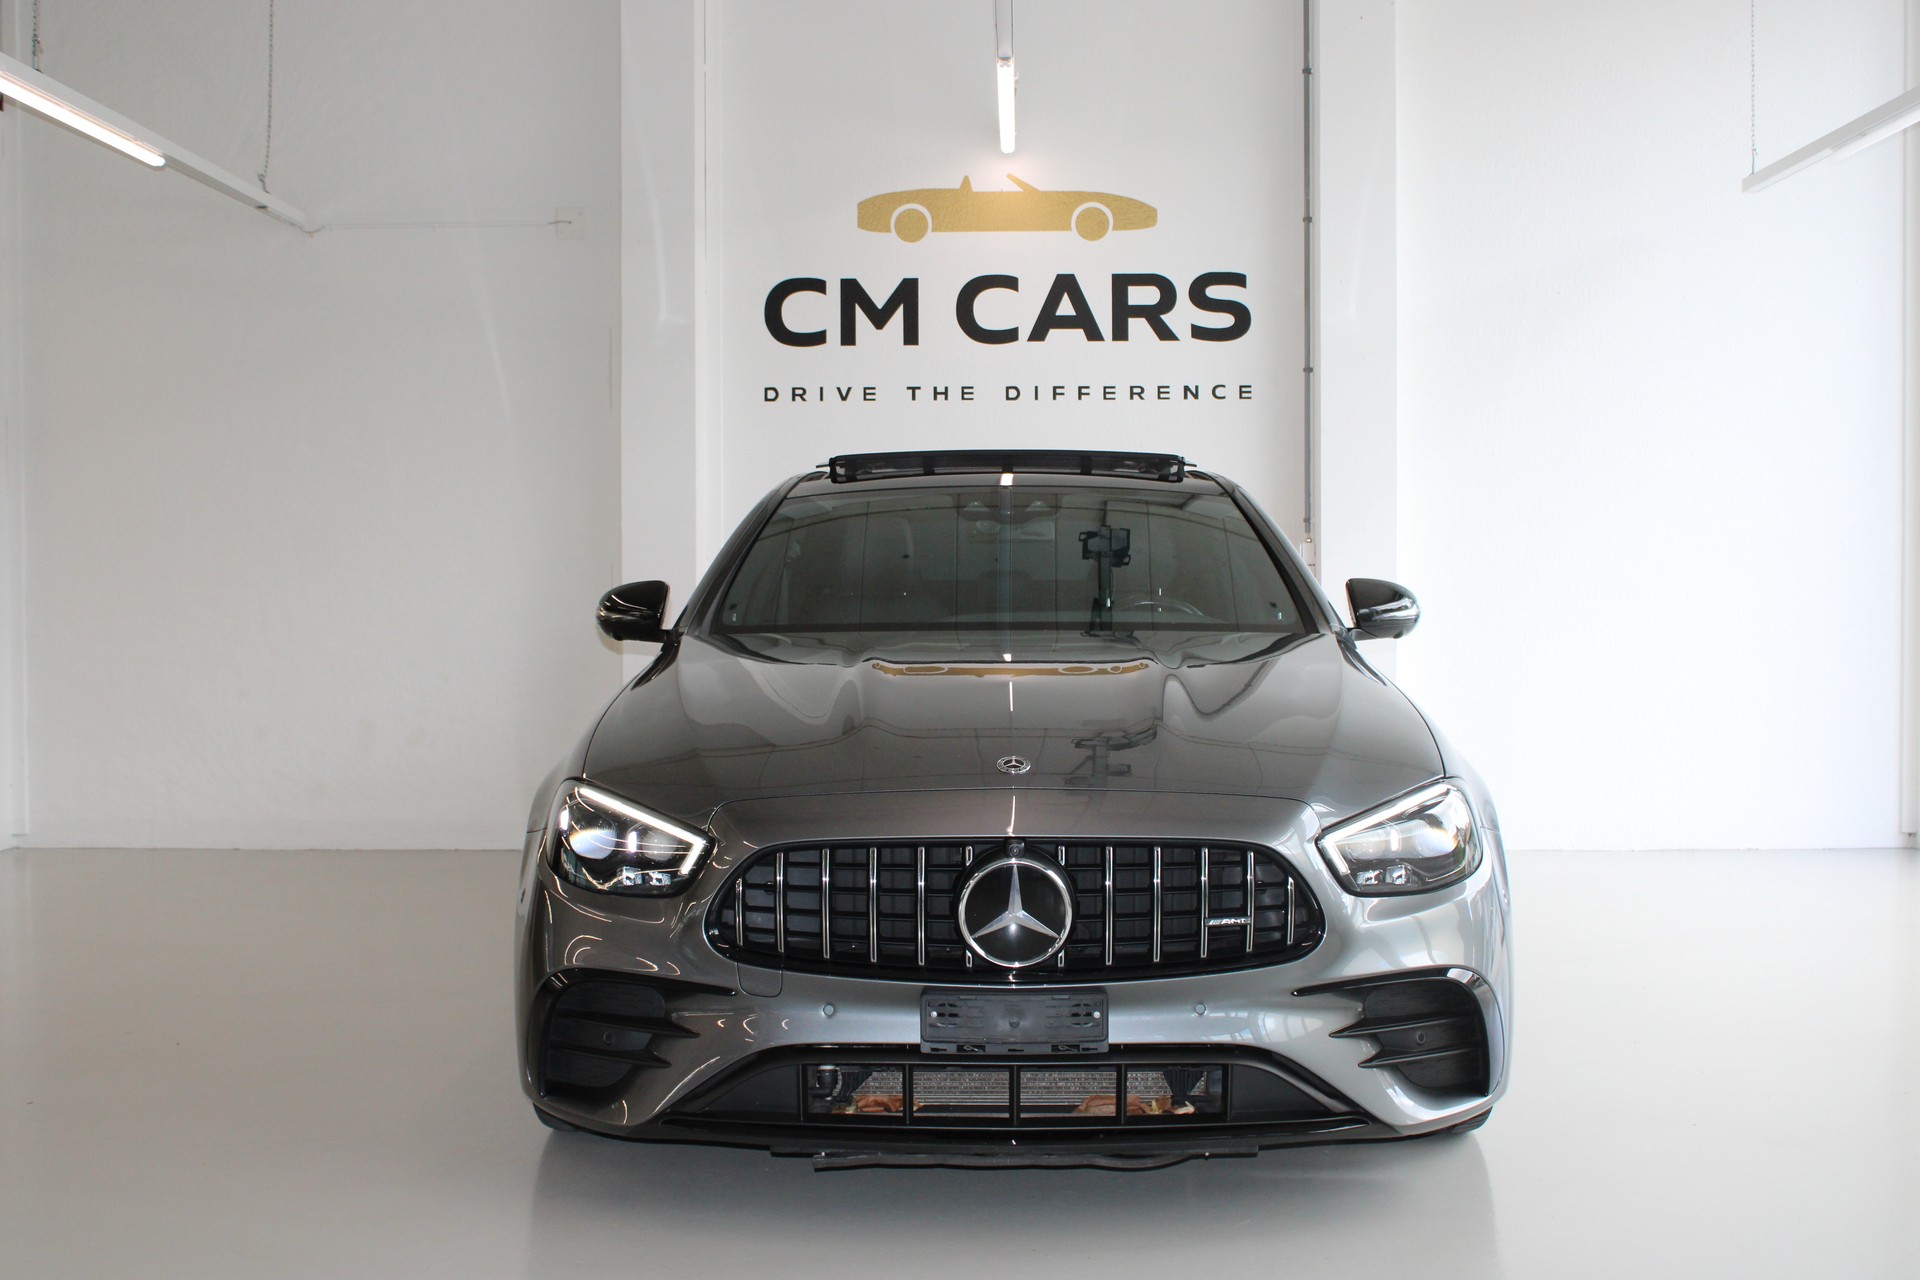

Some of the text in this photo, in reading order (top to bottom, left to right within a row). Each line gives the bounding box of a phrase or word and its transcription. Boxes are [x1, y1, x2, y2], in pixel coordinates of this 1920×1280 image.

[764, 271, 1252, 347] CM CARS
[764, 384, 1253, 402] DRIVE THE DIFFERENCE
